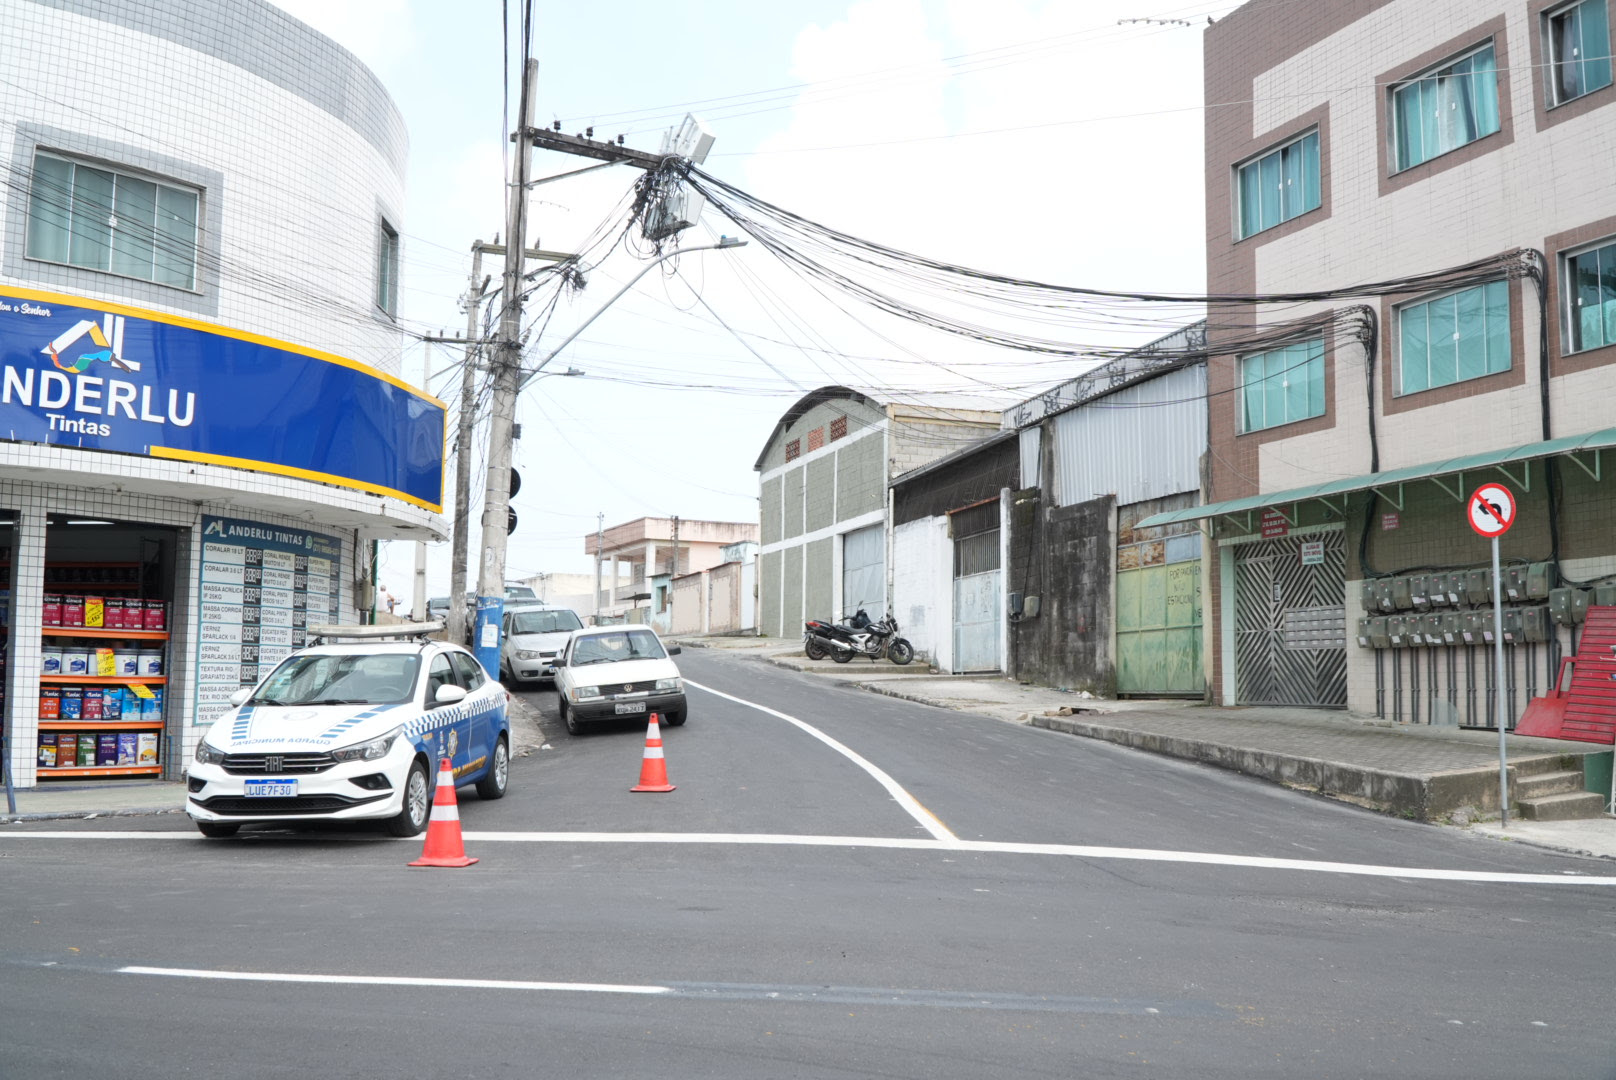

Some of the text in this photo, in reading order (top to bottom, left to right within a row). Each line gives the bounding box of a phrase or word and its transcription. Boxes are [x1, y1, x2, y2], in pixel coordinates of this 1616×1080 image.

[20, 303, 51, 317] Senhor
[46, 413, 111, 437] Tintas
[228, 525, 273, 541] ANDERLU
[274, 531, 303, 546] TINTAS
[206, 545, 231, 553] CORALAR
[264, 552, 278, 560] CORAL
[205, 565, 229, 573] CORALAR
[263, 571, 277, 579] CORAL
[261, 609, 276, 617] CORAL
[265, 756, 285, 772] FIAT
